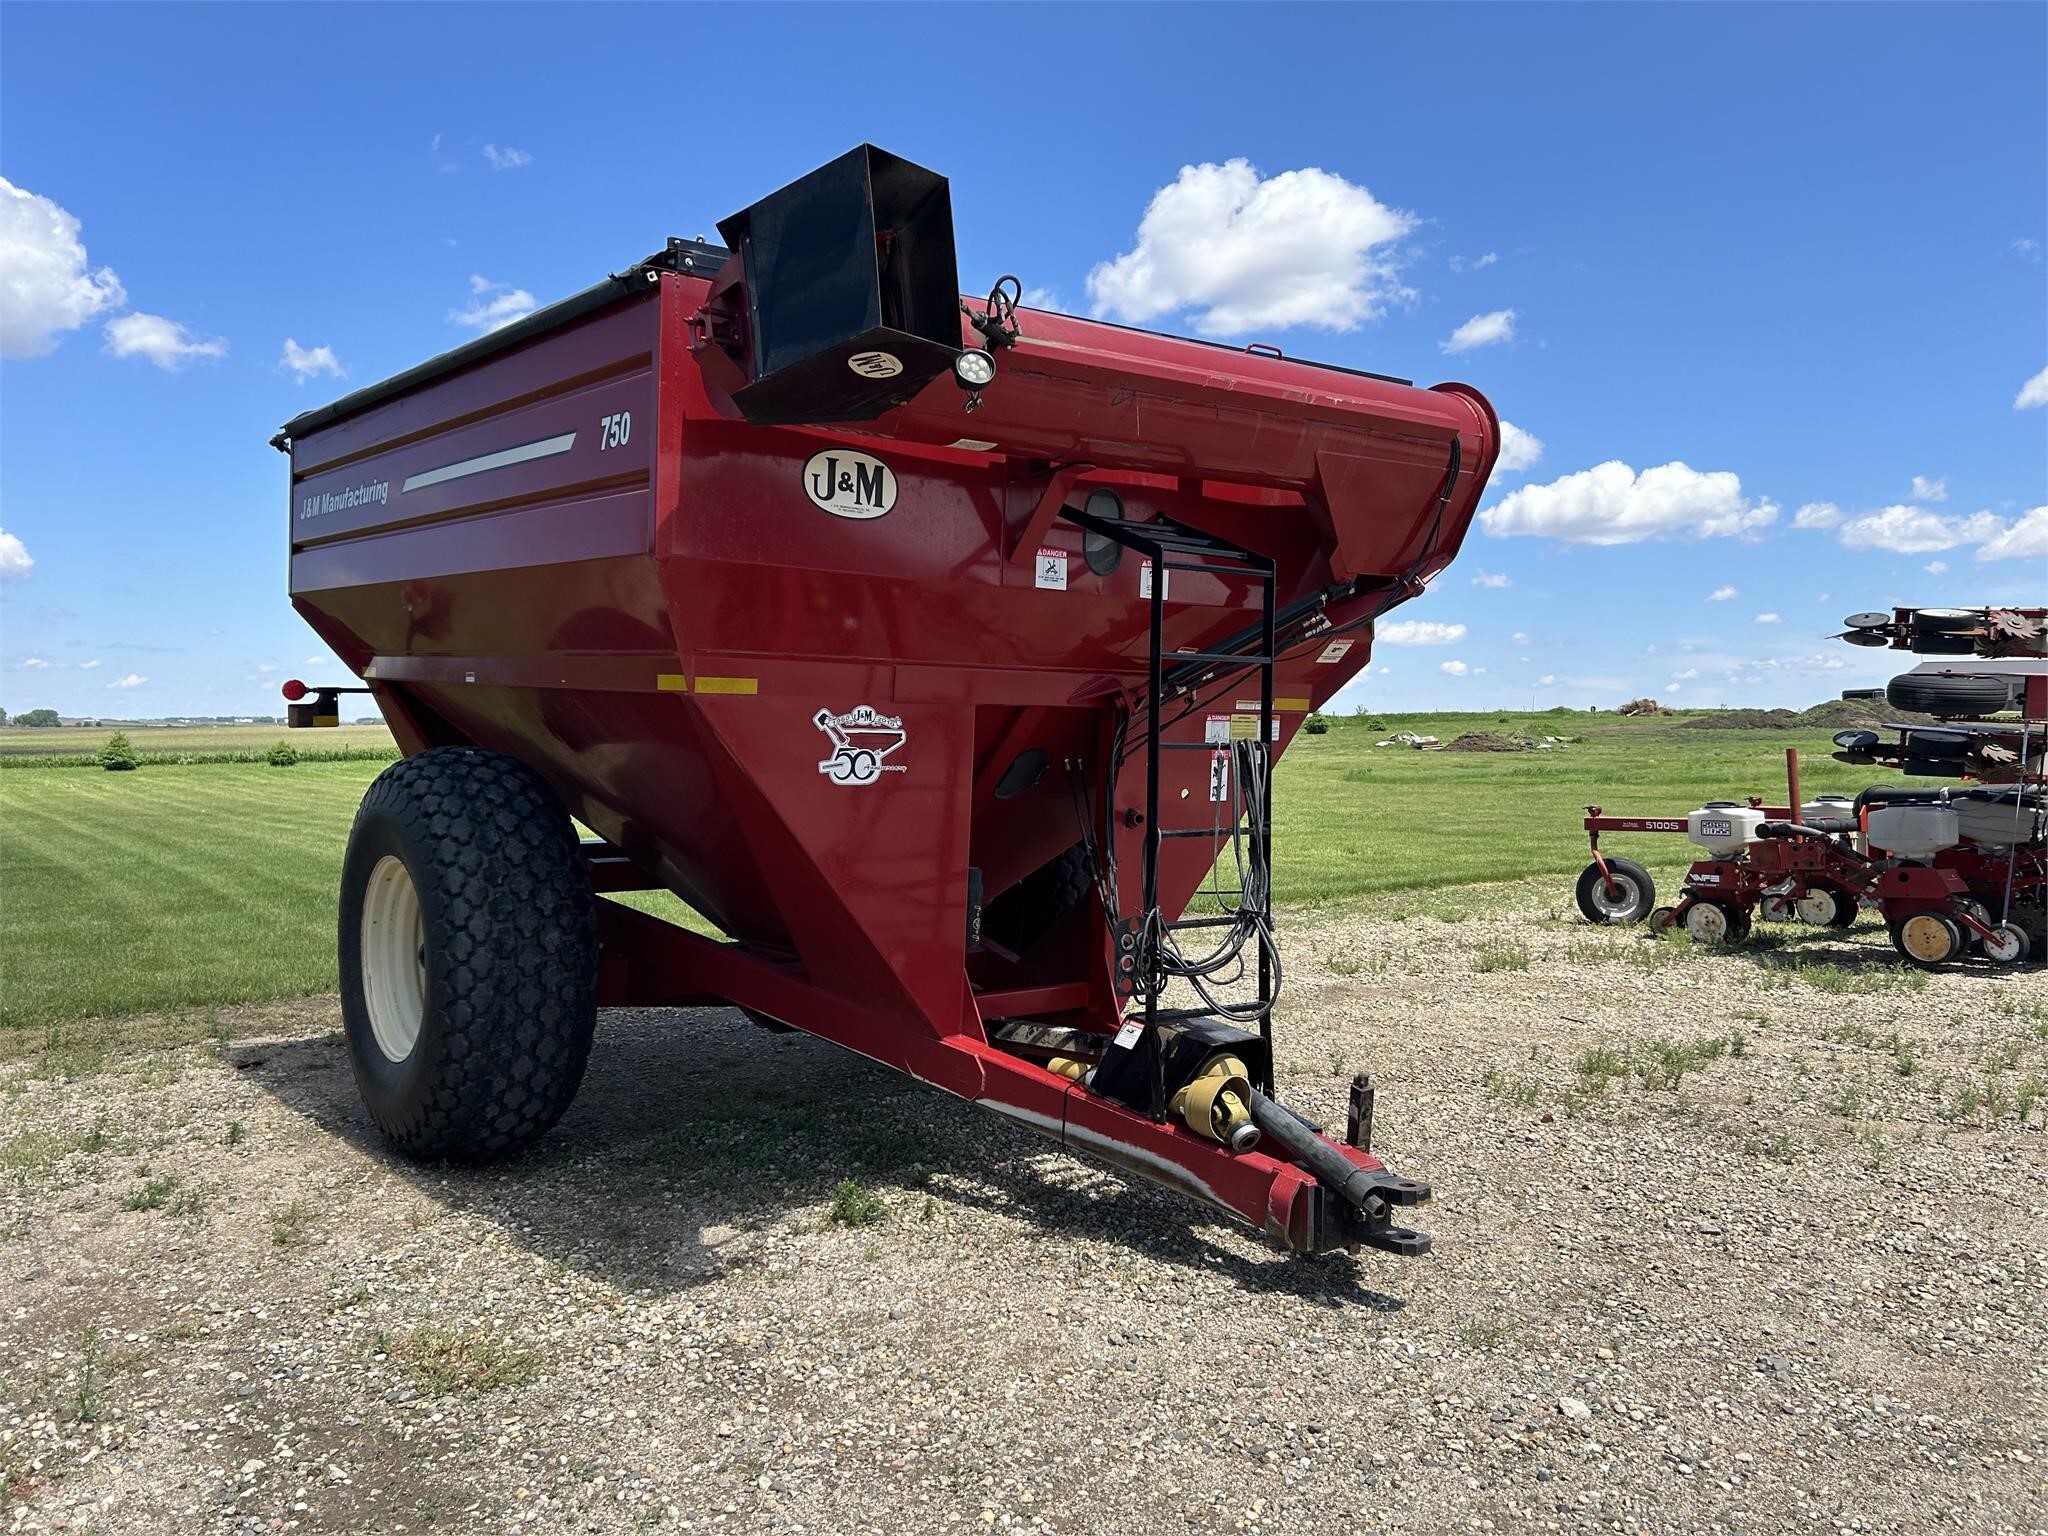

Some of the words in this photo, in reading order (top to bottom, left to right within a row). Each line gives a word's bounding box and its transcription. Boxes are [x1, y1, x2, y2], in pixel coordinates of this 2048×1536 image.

[851, 353, 896, 376] J&M
[600, 410, 632, 452] 750
[811, 456, 886, 509] J&M
[321, 479, 389, 515] Manufacturing
[1042, 549, 1067, 558] DANGER
[852, 709, 873, 723] J&M
[833, 747, 877, 781] 50
[1645, 821, 1680, 831] 5100S
[1703, 827, 1730, 836] BOSS
